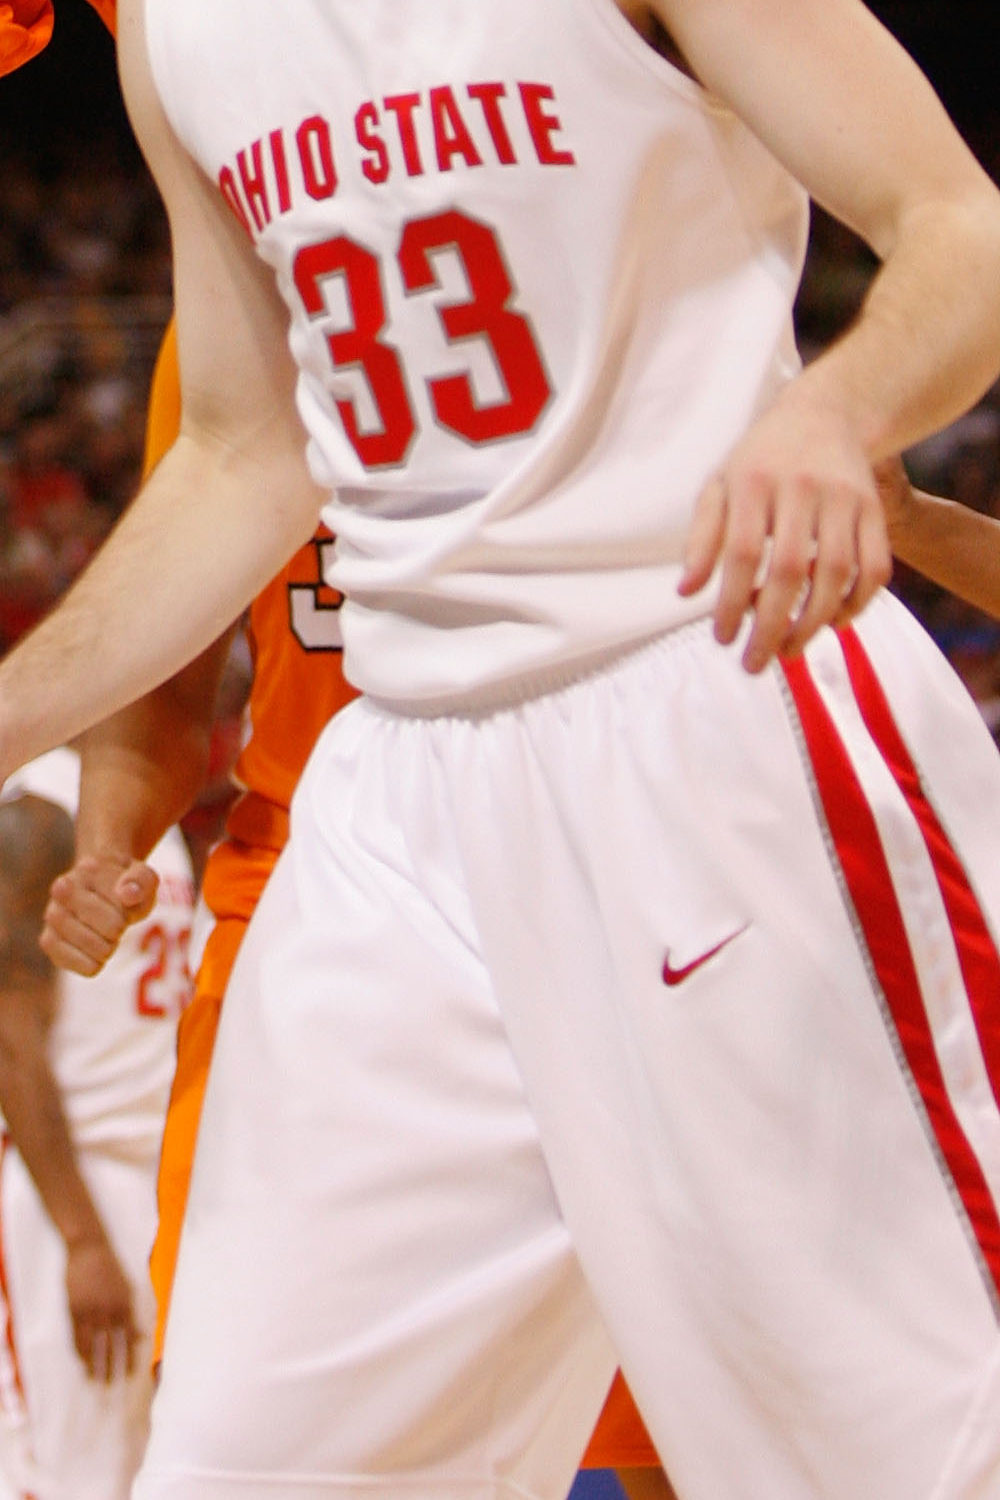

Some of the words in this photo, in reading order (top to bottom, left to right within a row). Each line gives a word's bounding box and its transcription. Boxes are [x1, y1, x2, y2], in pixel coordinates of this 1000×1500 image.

[218, 114, 339, 246] OHIO
[354, 82, 576, 185] STATE
[292, 204, 557, 473] 33
